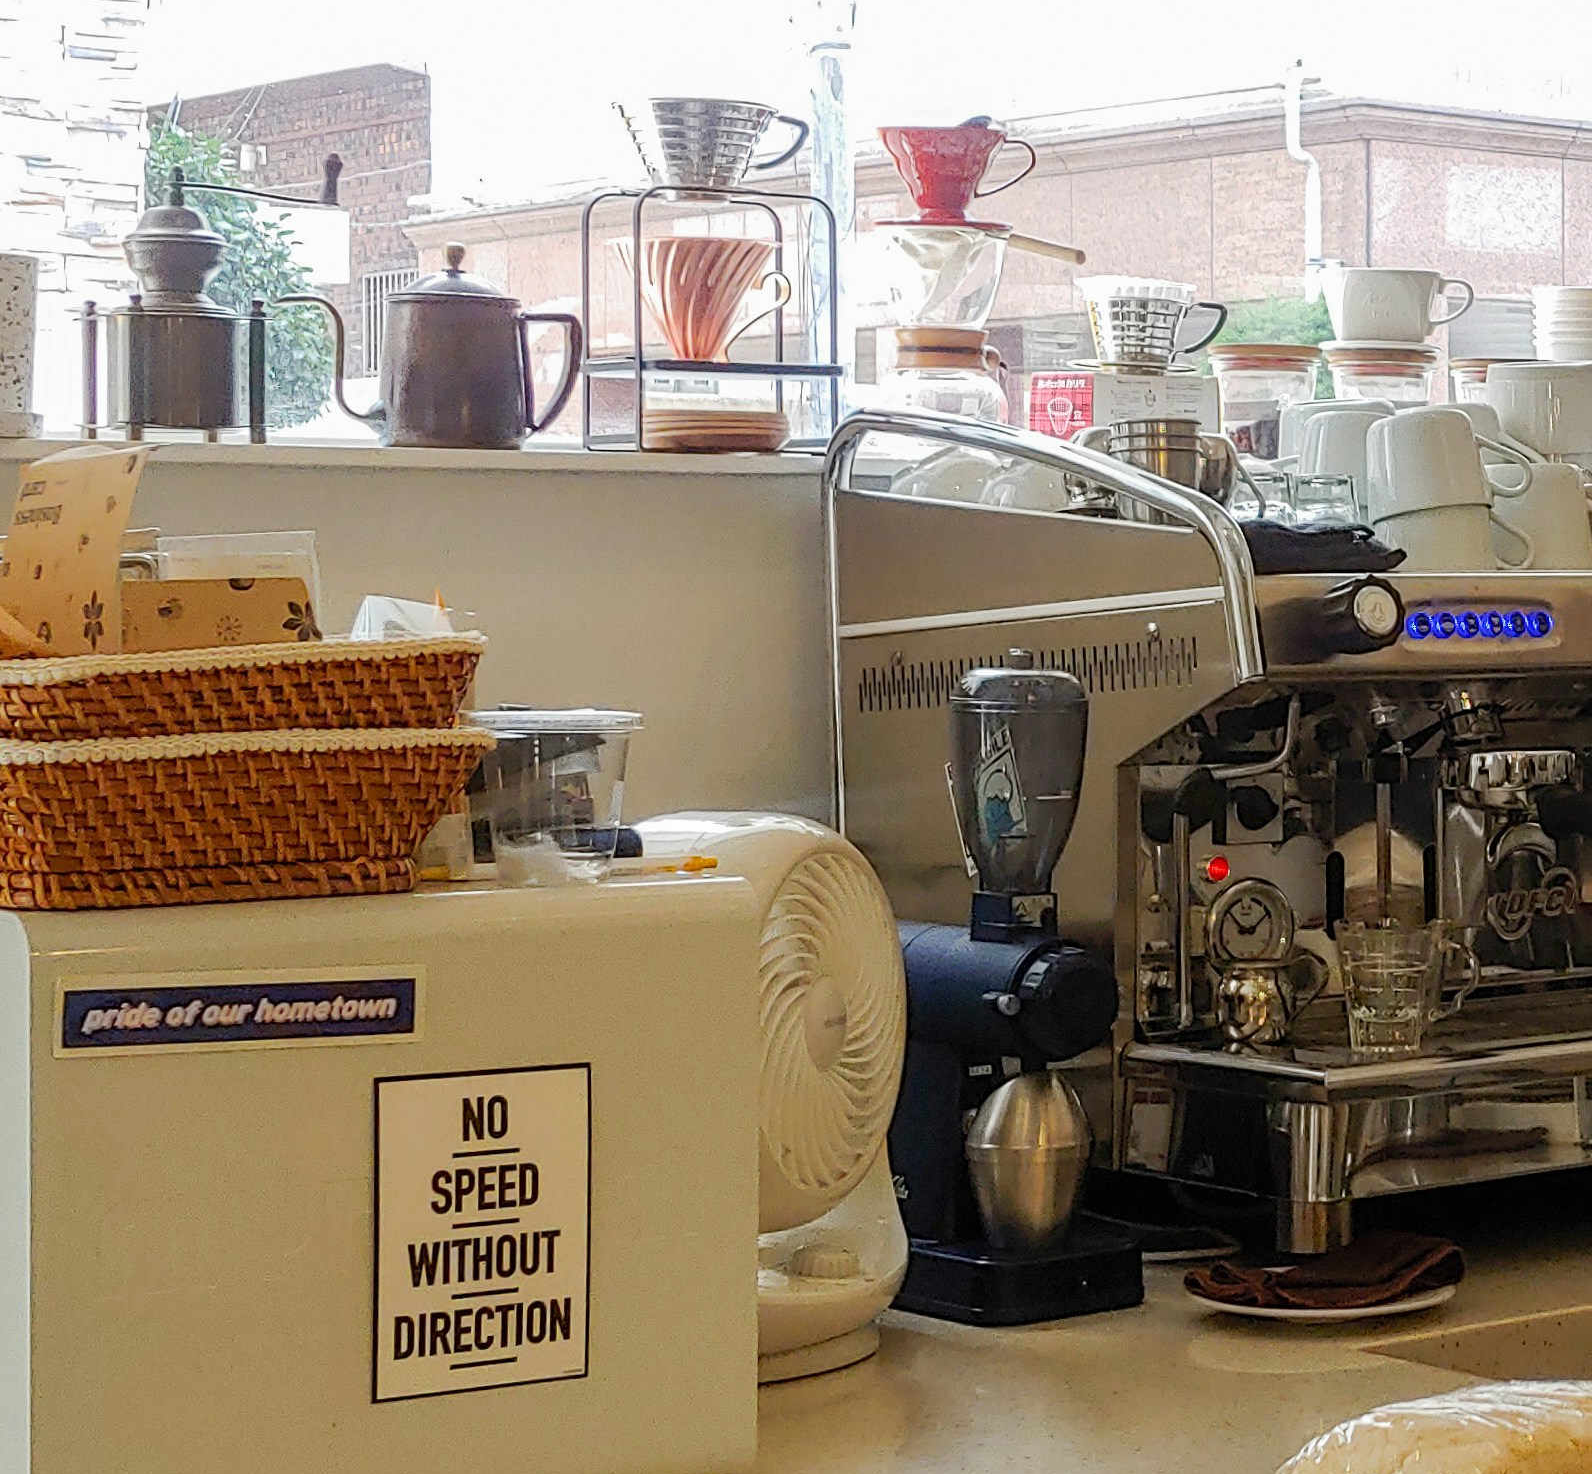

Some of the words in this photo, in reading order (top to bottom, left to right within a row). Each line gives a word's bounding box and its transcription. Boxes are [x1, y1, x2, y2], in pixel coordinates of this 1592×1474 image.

[81, 1002, 160, 1035] pride
[165, 999, 204, 1027] of
[202, 1002, 252, 1026] our
[253, 995, 398, 1023] hometown
[462, 1094, 508, 1142] NO
[430, 1162, 539, 1215] SPEED
[407, 1229, 561, 1288] WITHOUT
[393, 1297, 572, 1361] DIRECTION
